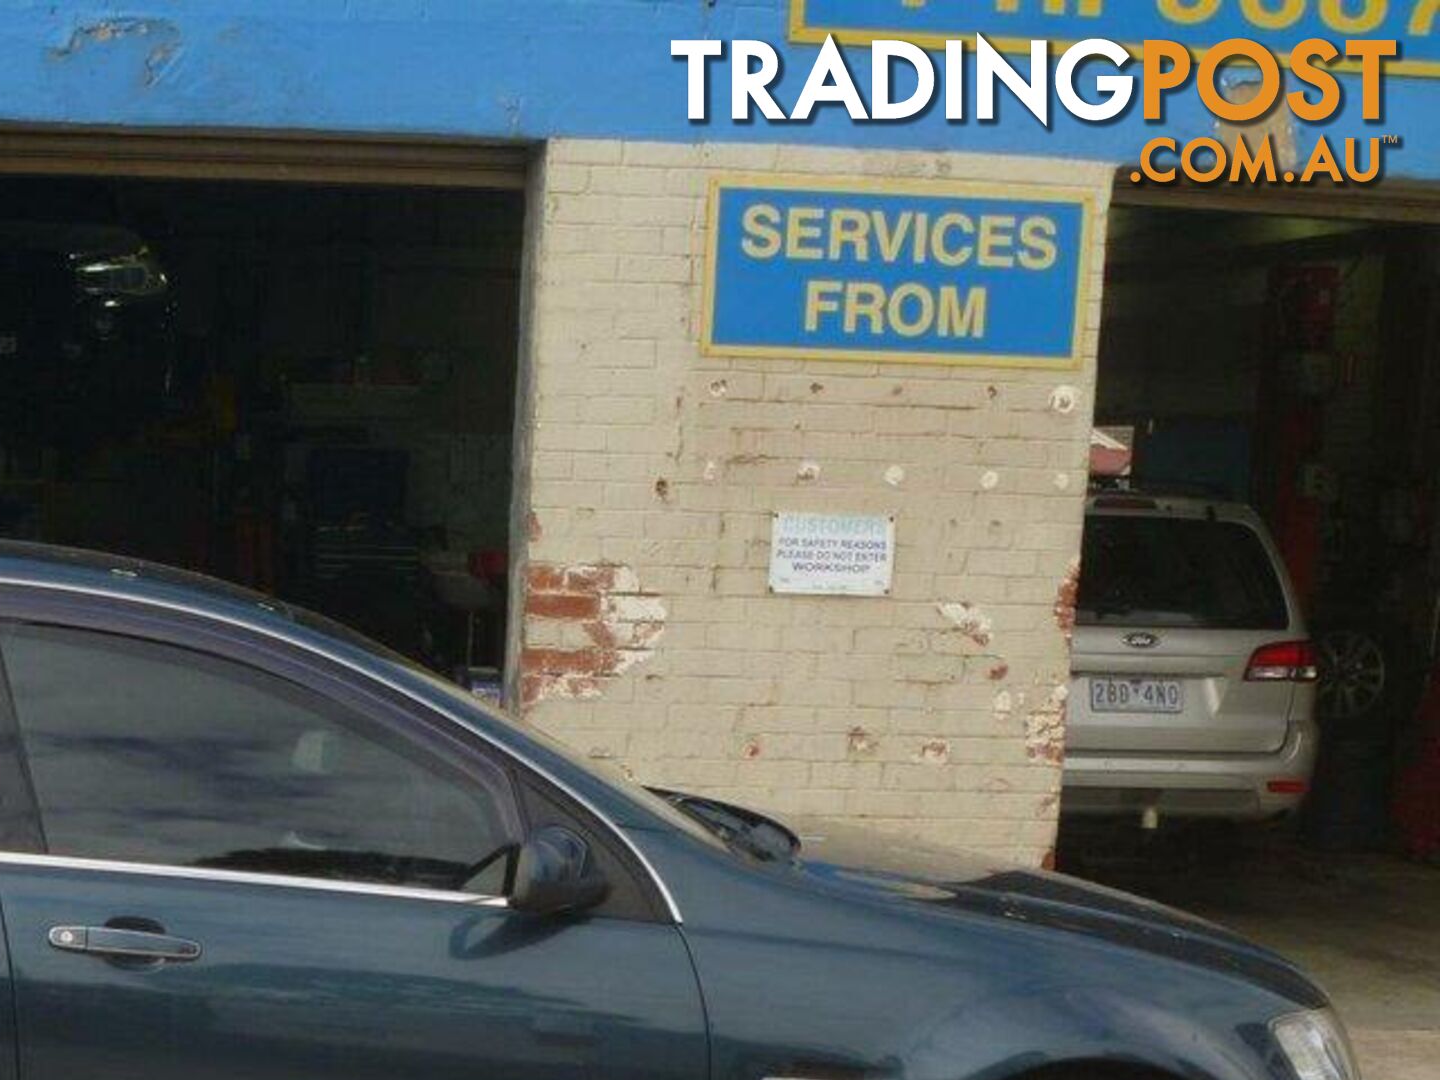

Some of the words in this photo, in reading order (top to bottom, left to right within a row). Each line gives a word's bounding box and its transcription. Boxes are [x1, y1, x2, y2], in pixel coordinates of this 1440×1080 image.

[740, 204, 1058, 271] SERVICES
[803, 281, 987, 339] FROM
[779, 537, 800, 547] FOR
[802, 537, 839, 549] SAFETY
[841, 539, 888, 550] REASONS
[776, 548, 815, 560] PLEASE
[817, 550, 831, 560] DO
[833, 552, 853, 562] NOT
[855, 552, 888, 563] ENTER
[792, 561, 871, 575] WORKSHOP
